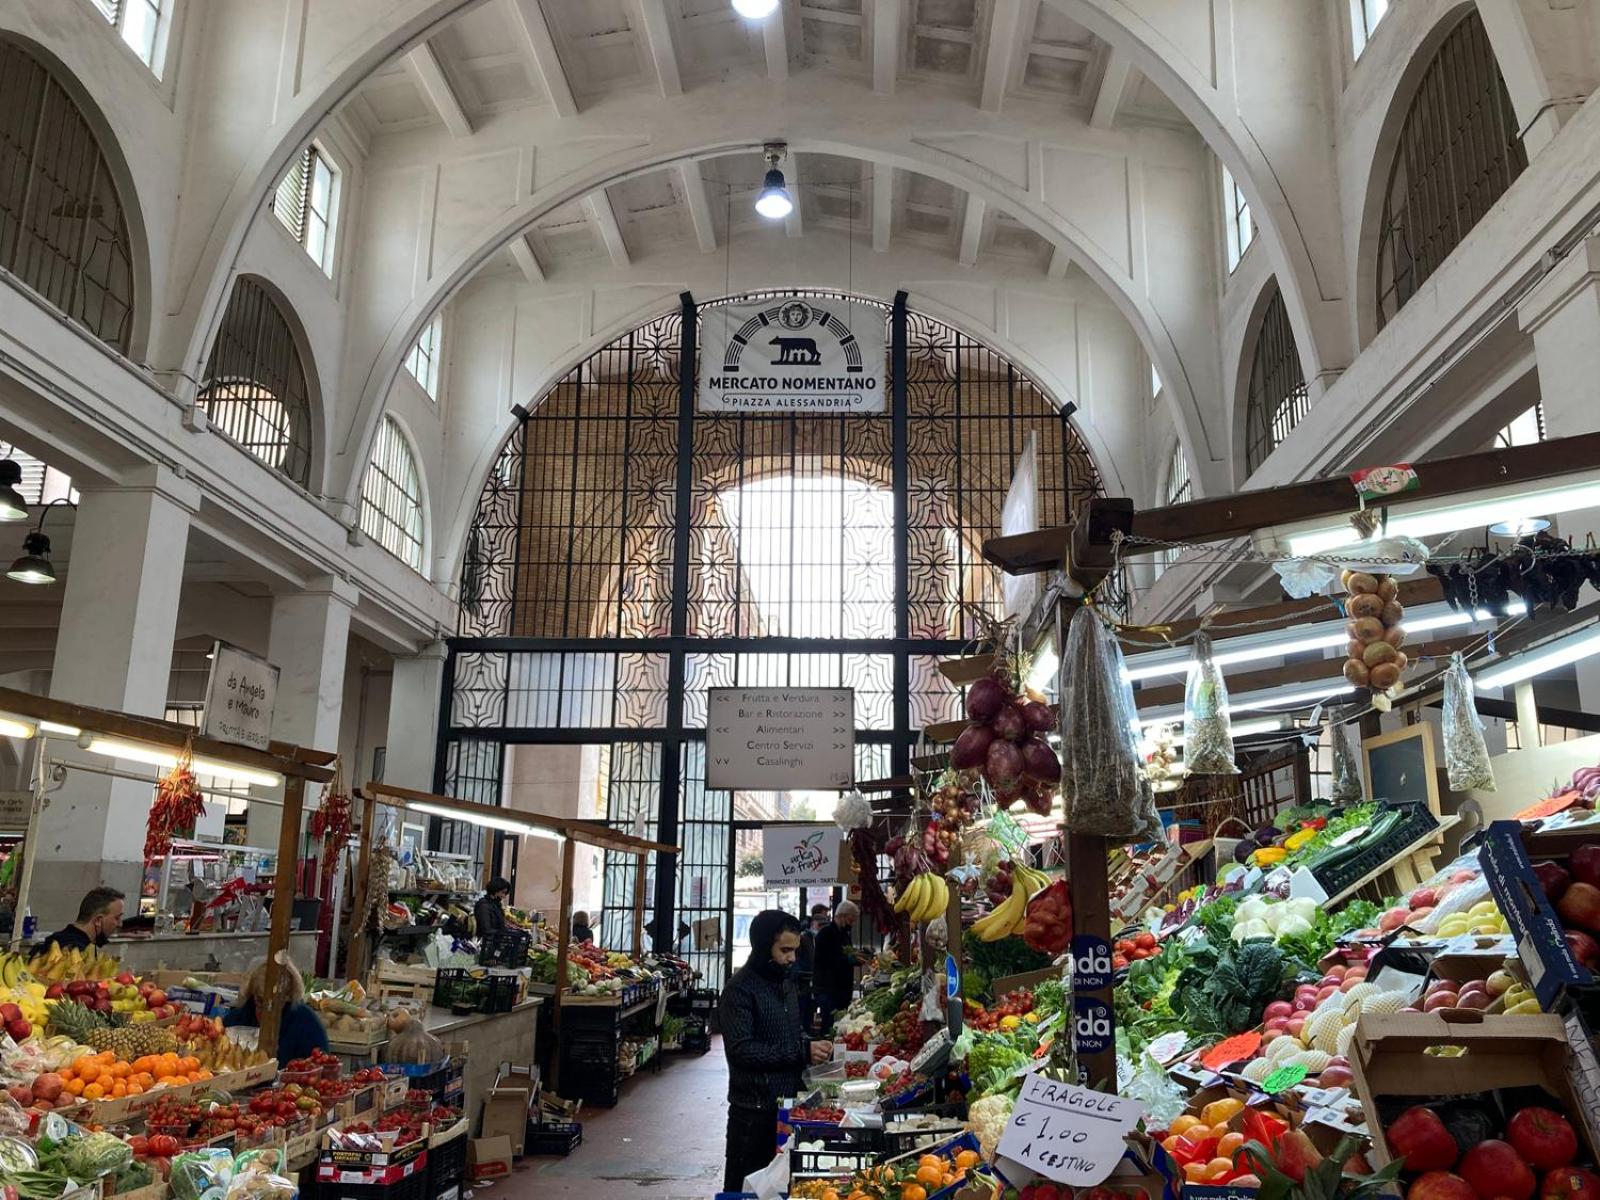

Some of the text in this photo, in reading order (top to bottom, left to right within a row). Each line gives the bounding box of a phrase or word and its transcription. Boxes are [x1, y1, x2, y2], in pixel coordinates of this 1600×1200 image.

[709, 377, 876, 390] MERCATO NOMENTANO
[732, 398, 851, 407] PIAZZA ALESSANDRIA
[227, 672, 265, 702] da Angela
[742, 693, 770, 702] Frutta
[782, 693, 819, 702] Verdura
[236, 700, 260, 719] Mauro
[738, 709, 752, 718] Bar
[766, 709, 823, 718] Ristorazione
[756, 725, 804, 734] Alimentari
[747, 740, 814, 750] Centro Servizi
[757, 756, 803, 768] Casalinghi
[1083, 977, 1103, 985] NON
[1082, 1040, 1102, 1048] NON
[1030, 1080, 1121, 1112] FRAGOLE
[1015, 1112, 1088, 1143] € 1.00
[1021, 1143, 1096, 1173] A CESTINO
